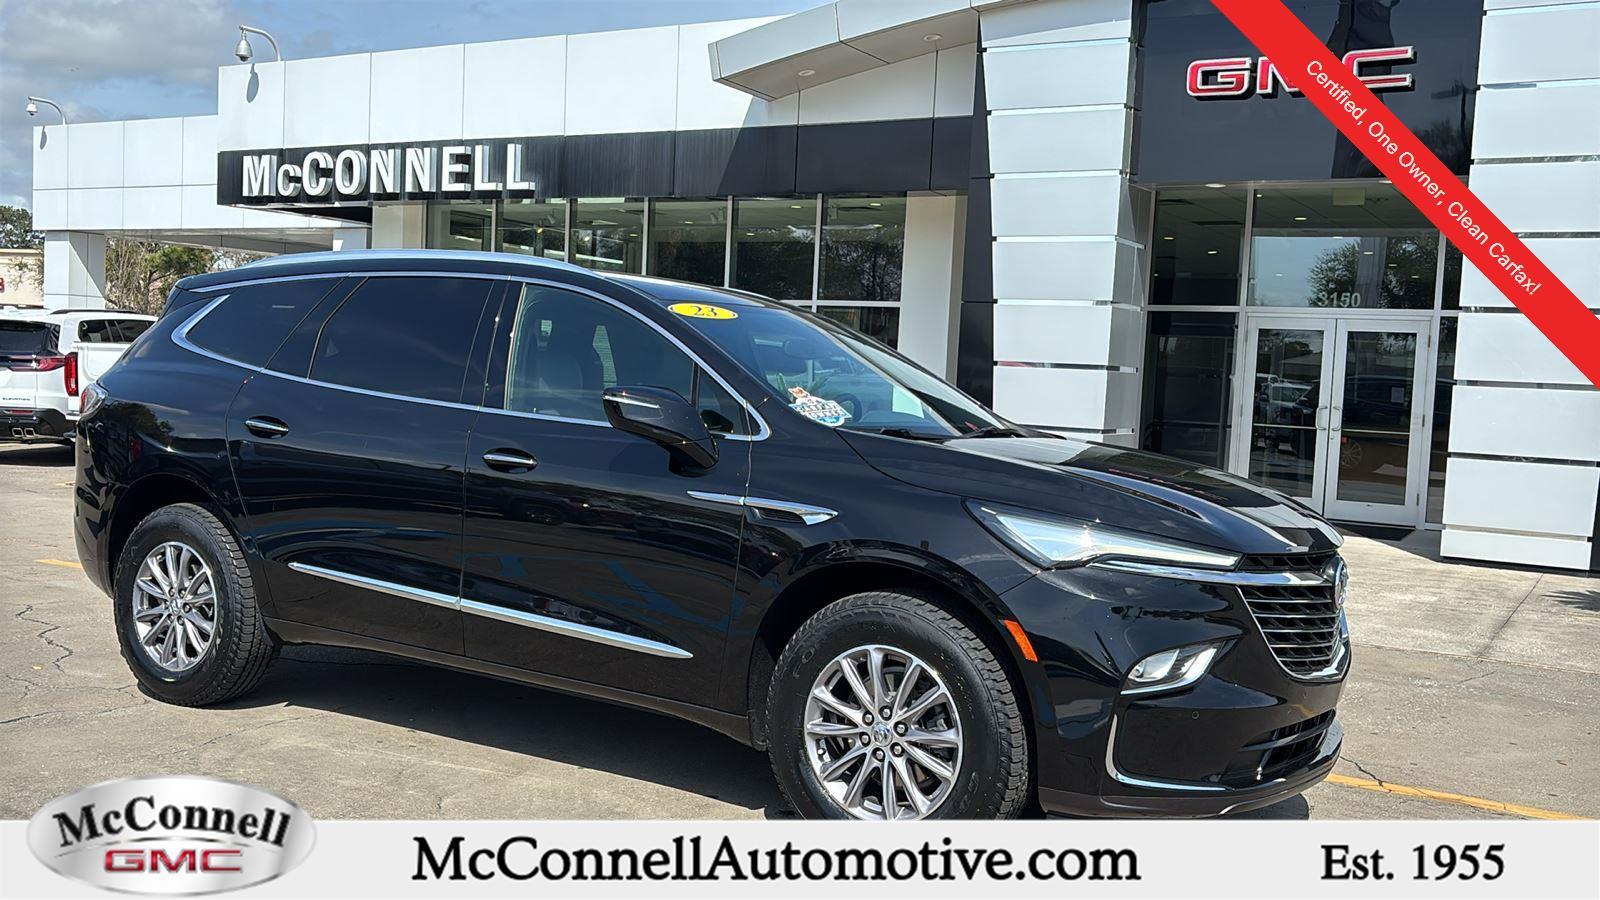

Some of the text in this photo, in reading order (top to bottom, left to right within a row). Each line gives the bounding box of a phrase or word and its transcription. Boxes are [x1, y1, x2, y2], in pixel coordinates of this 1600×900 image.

[241, 143, 536, 198] McCONNELL
[1317, 291, 1361, 308] 3150
[690, 305, 718, 317] 23
